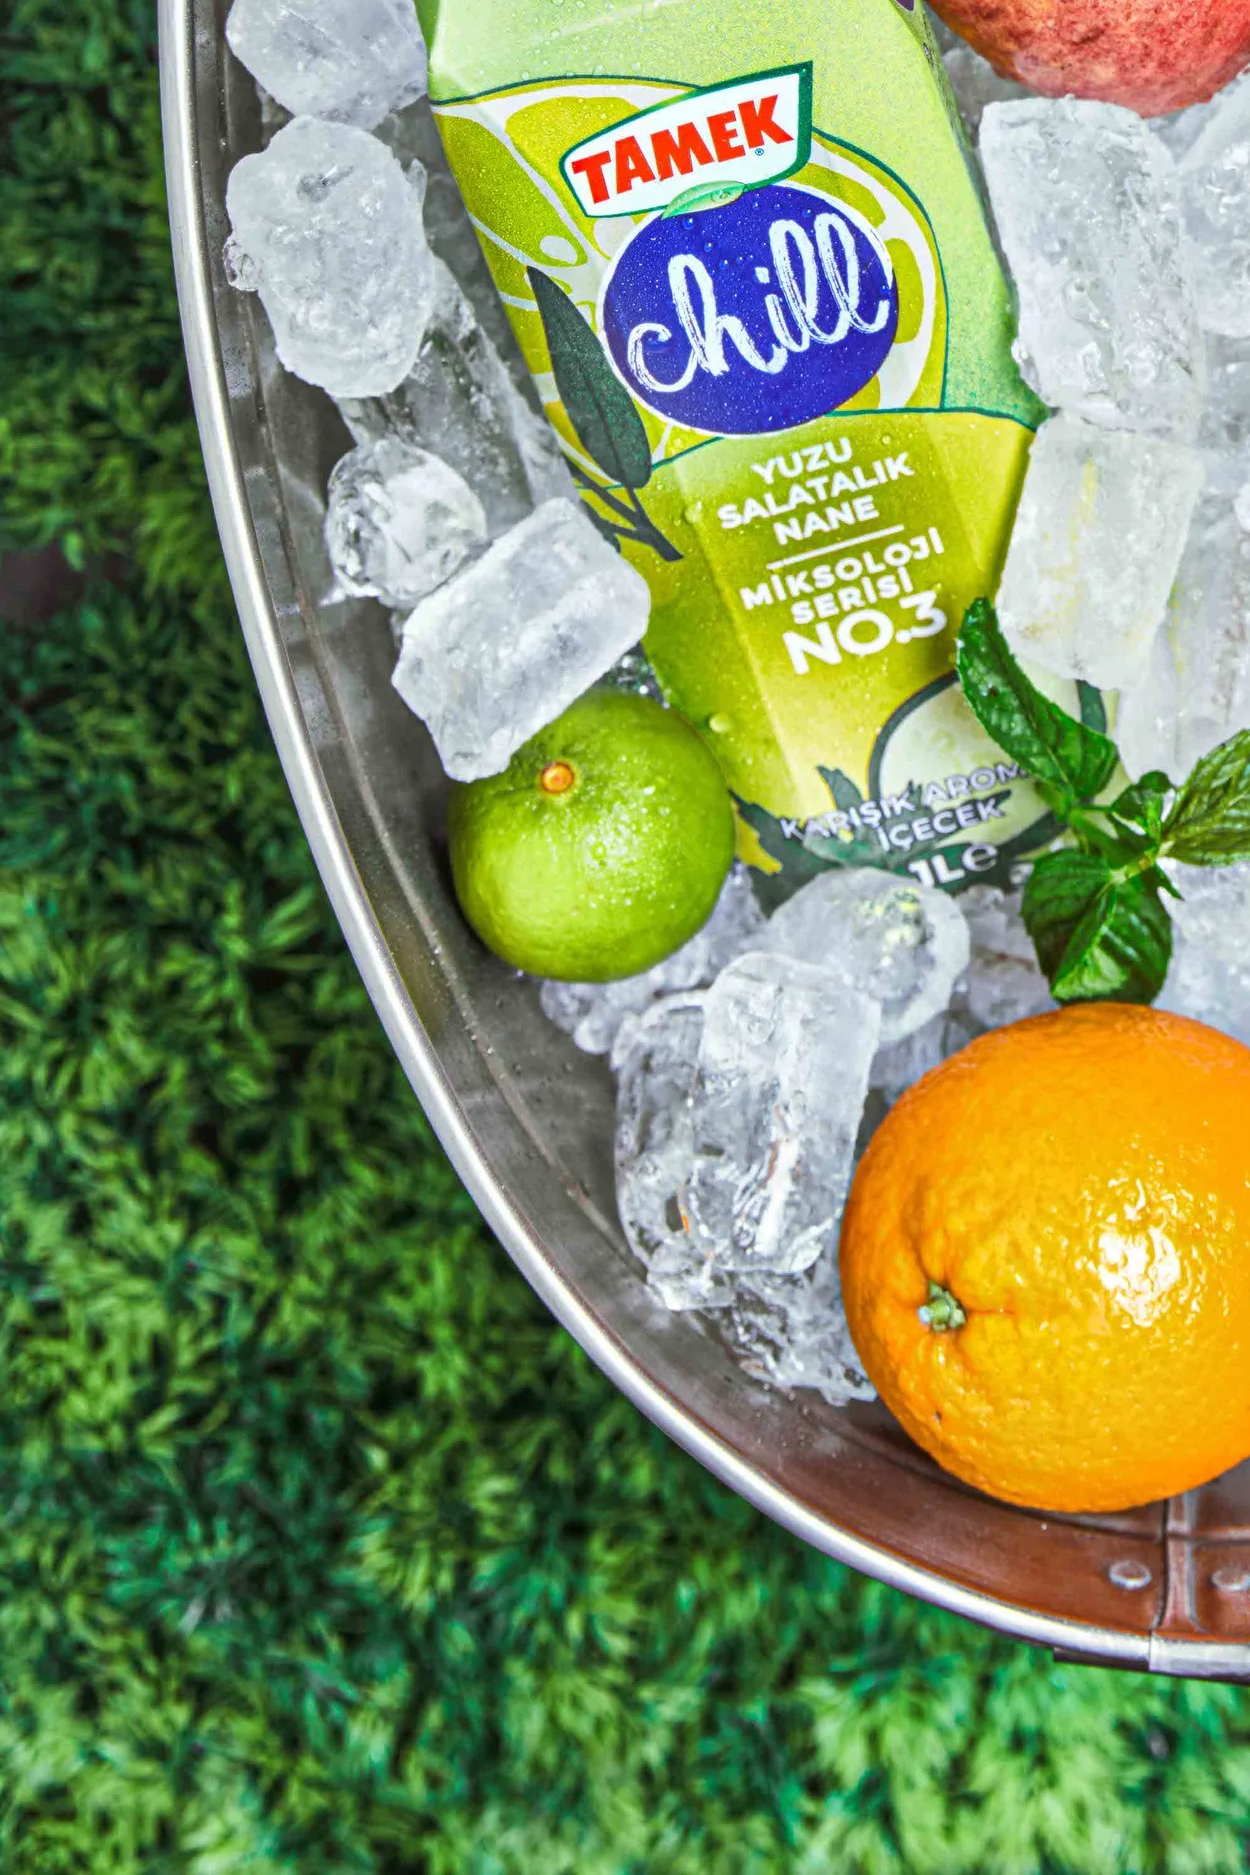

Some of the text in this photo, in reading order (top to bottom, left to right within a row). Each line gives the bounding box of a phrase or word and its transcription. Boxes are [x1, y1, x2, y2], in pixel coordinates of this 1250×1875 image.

[572, 94, 794, 205] TAMEK
[627, 212, 890, 392] chill
[717, 452, 915, 529] SALATALIK
[752, 437, 853, 485] YUZU
[773, 495, 879, 545] NANE
[739, 527, 945, 610] MİKSOLOJİ
[790, 566, 913, 624] SERİSİ
[783, 590, 947, 675] NO.3
[779, 791, 917, 841] KARIŞIK
